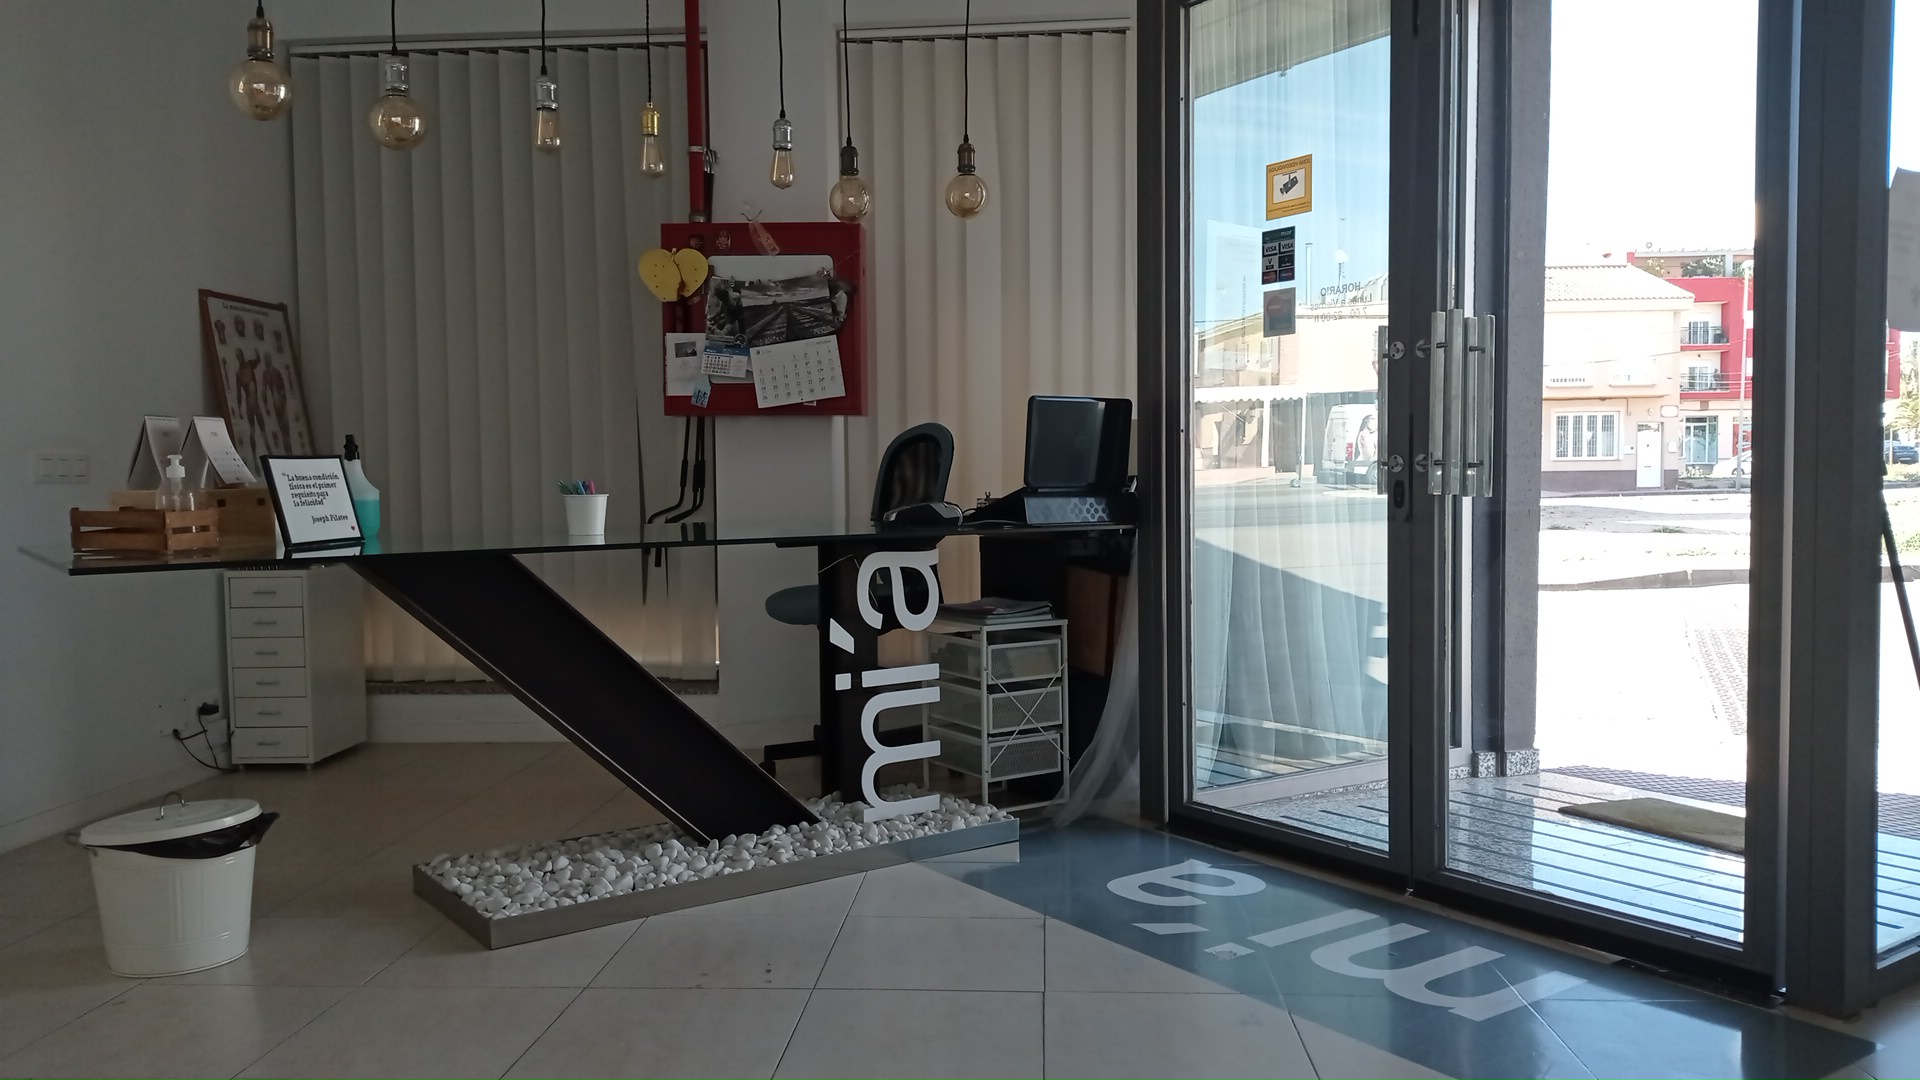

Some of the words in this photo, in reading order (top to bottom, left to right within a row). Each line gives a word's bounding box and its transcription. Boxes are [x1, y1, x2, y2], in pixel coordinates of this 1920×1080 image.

[1265, 245, 1277, 253] VISA
[1281, 242, 1294, 250] VISA
[312, 472, 340, 480] condición
[318, 482, 337, 490] primer
[291, 491, 316, 499] requisito
[316, 491, 329, 499] para
[311, 515, 329, 524] Joseph
[329, 514, 349, 522] Pilates
